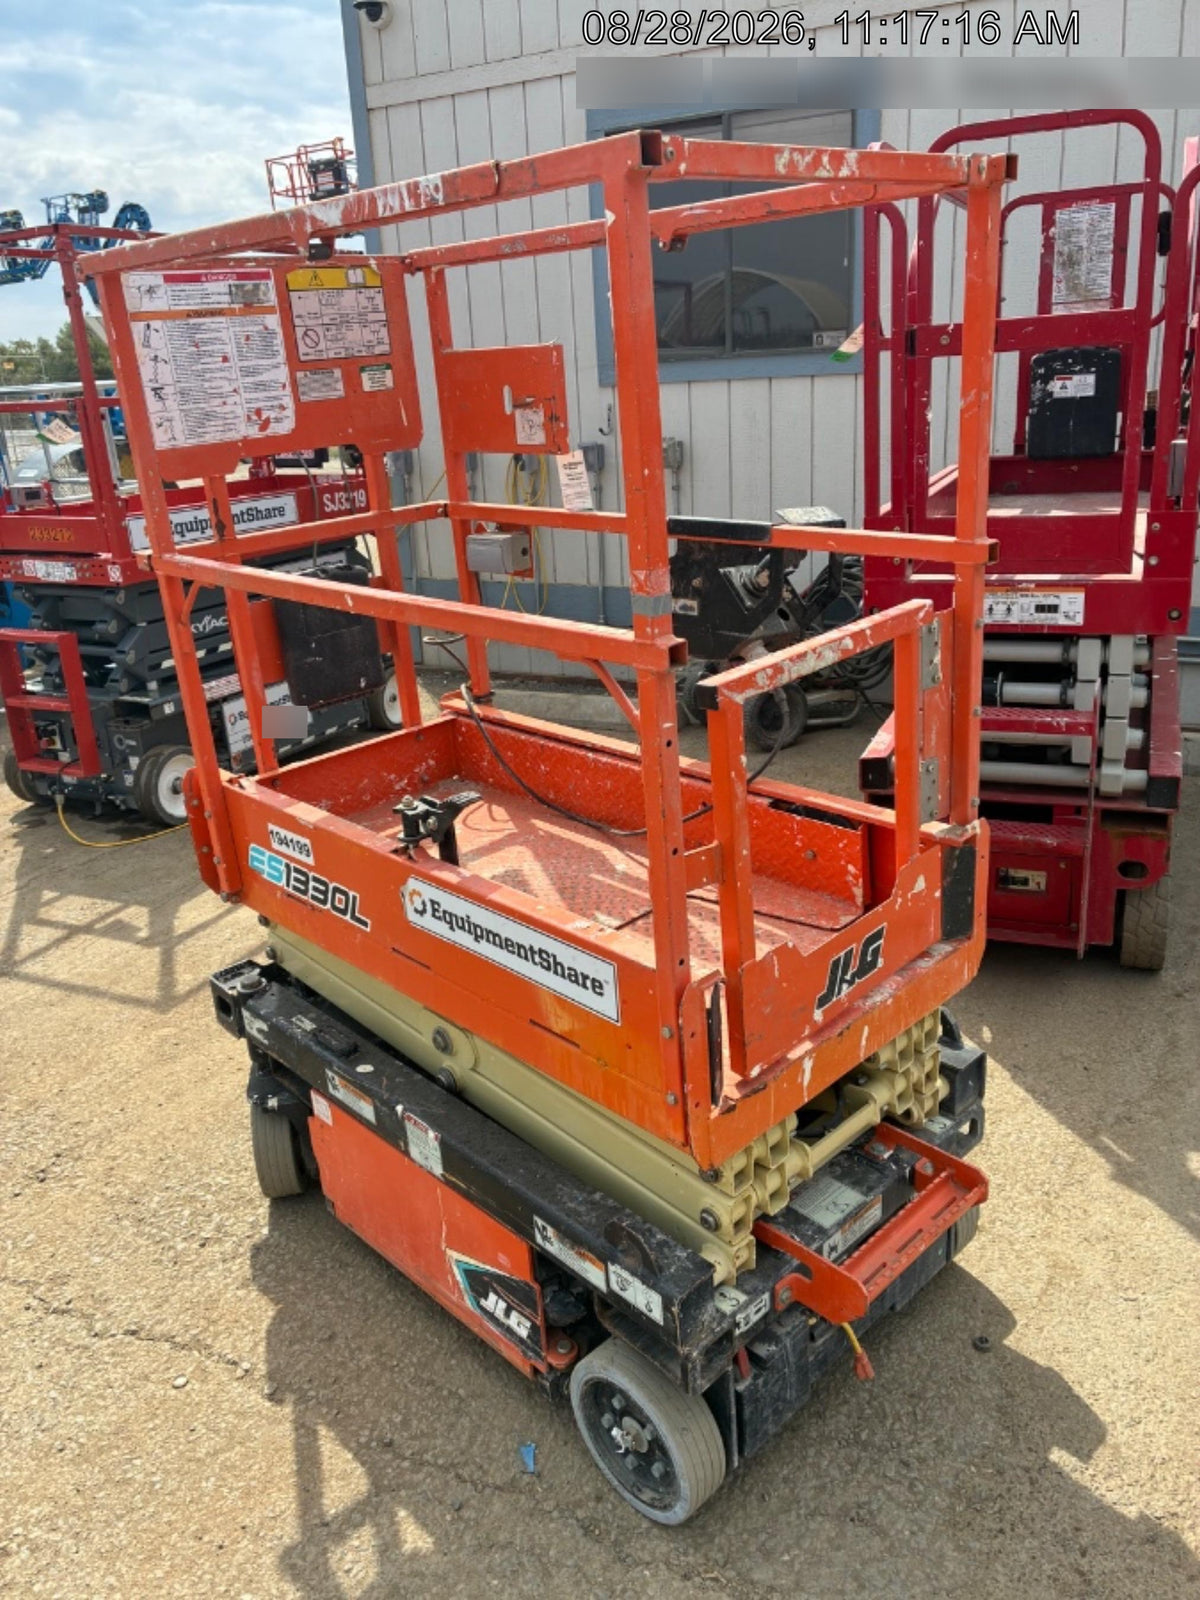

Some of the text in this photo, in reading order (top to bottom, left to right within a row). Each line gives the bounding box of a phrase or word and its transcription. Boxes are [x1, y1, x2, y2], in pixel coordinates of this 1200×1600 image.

[170, 504, 286, 538] quipntShare
[269, 829, 311, 858] 194199
[248, 843, 371, 932] ES1330L
[429, 899, 605, 998] EquipmentShare
[815, 923, 887, 1012] JLG
[480, 1292, 533, 1339] JLG
